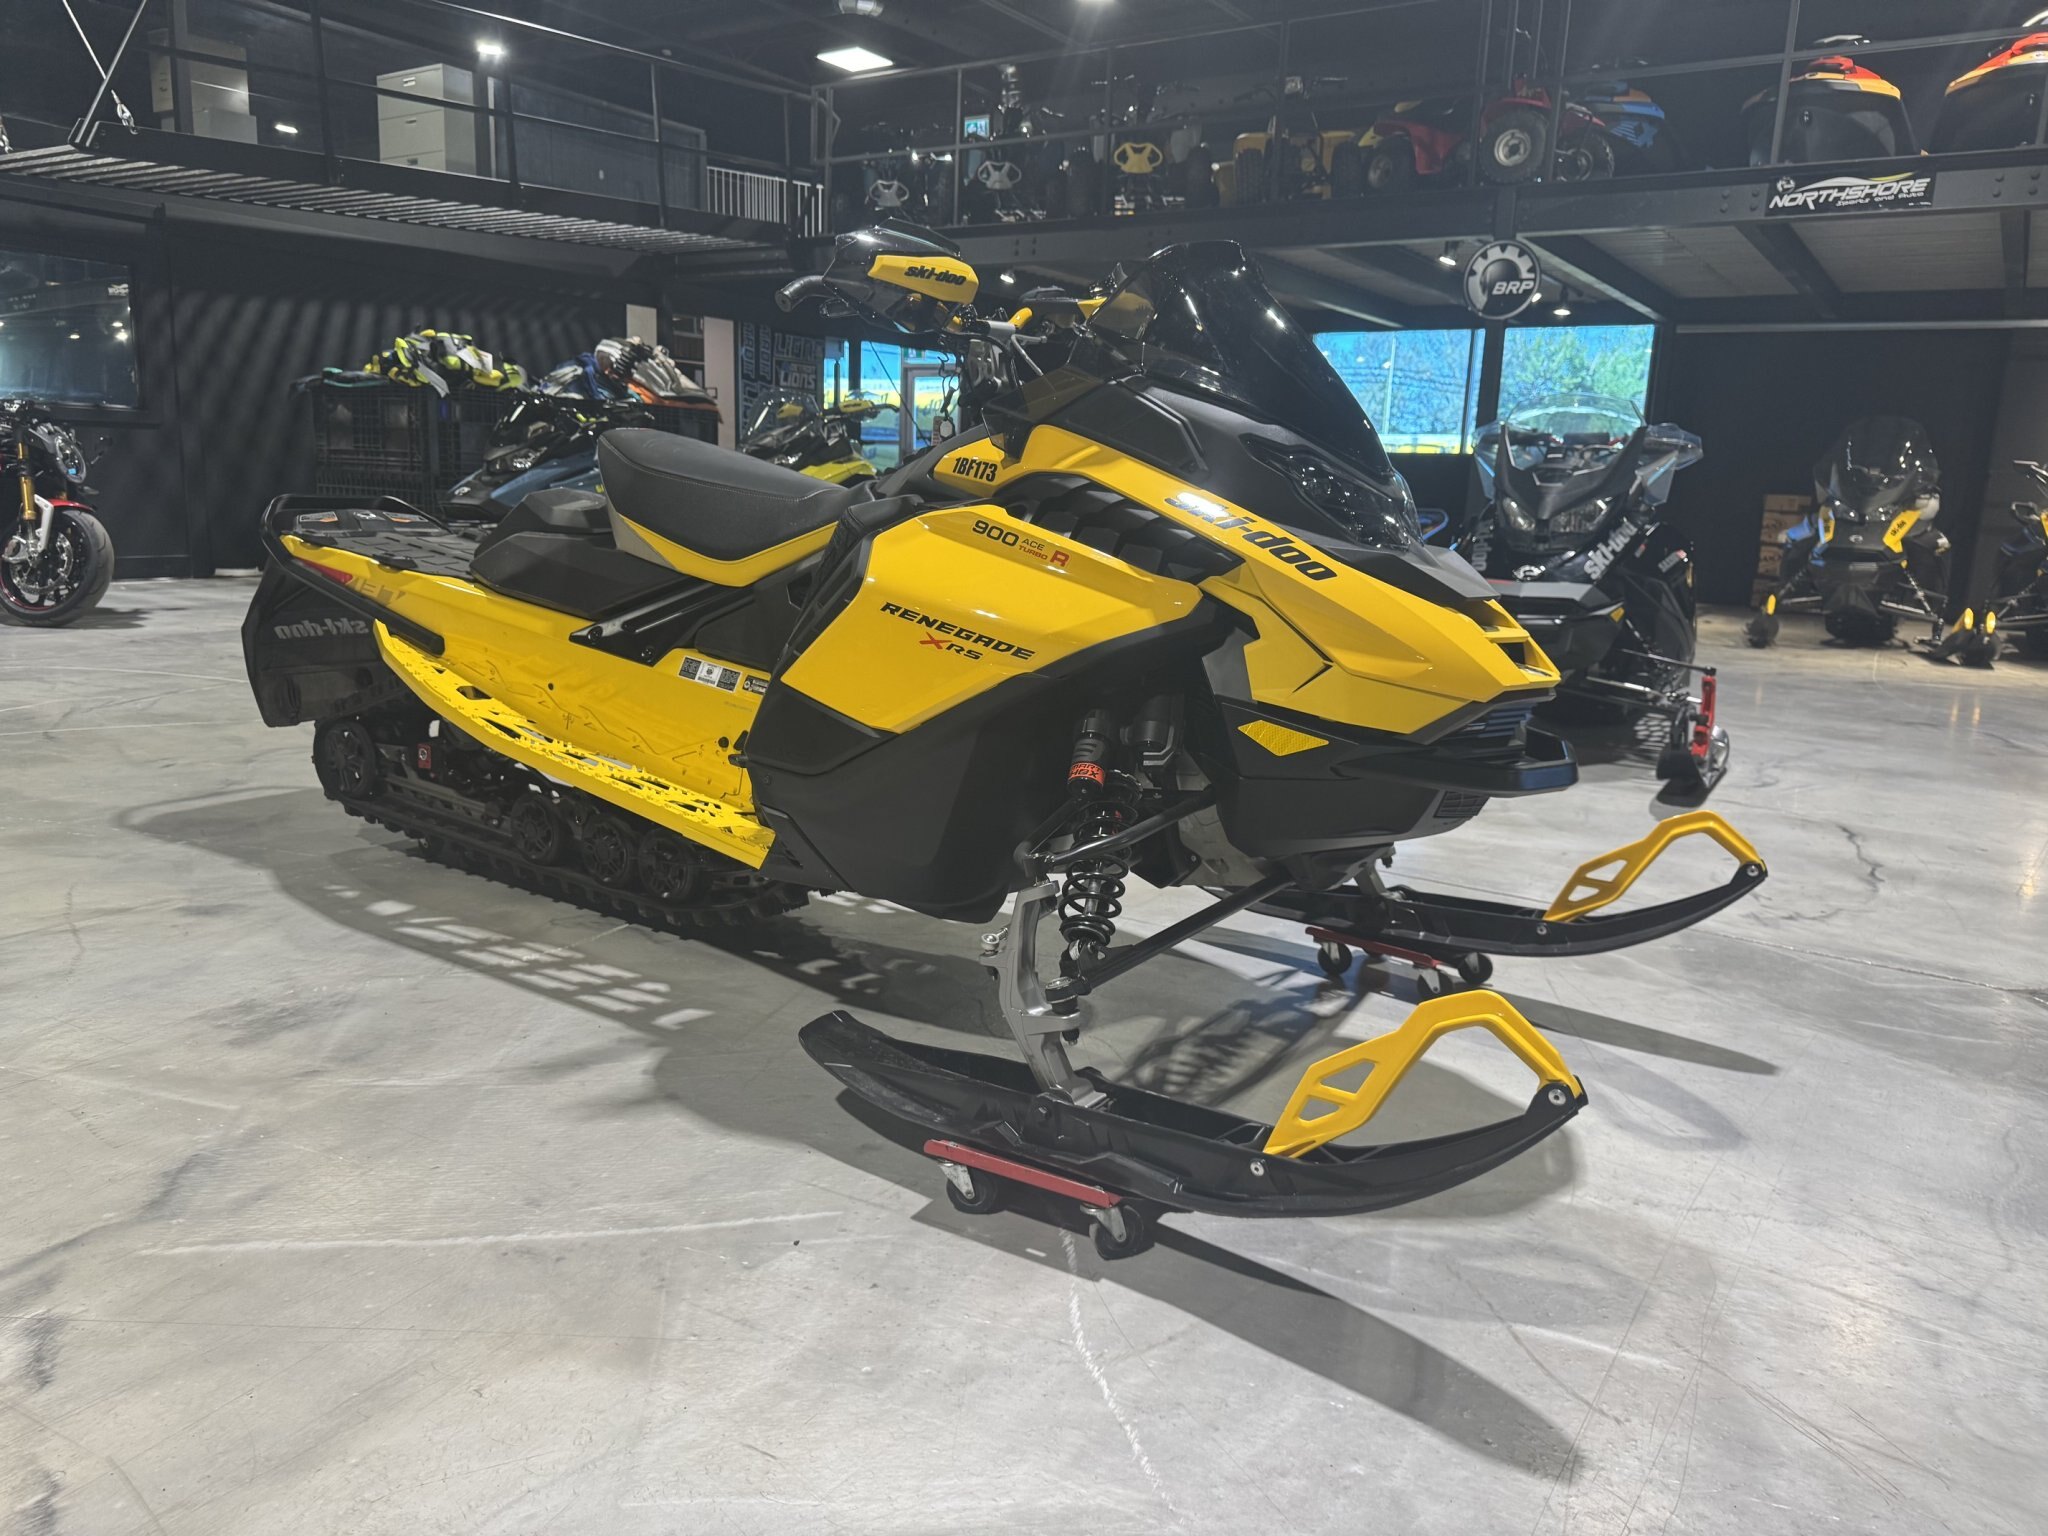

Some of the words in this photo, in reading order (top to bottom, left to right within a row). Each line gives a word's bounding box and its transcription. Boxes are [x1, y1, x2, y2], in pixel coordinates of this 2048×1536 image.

[1769, 178, 1931, 210] NORTHSHORE
[1835, 197, 1870, 207] Sports
[904, 265, 967, 286] ski-doo
[1491, 280, 1535, 295] BRP
[952, 457, 998, 482] 1BF173
[972, 520, 1019, 546] 900
[1021, 538, 1045, 551] ACE
[1164, 493, 1338, 581] ski-doo
[1018, 545, 1048, 560] TURBO
[1050, 550, 1070, 567] R
[880, 601, 1035, 661] RENEGADE
[919, 631, 983, 660] XRS
